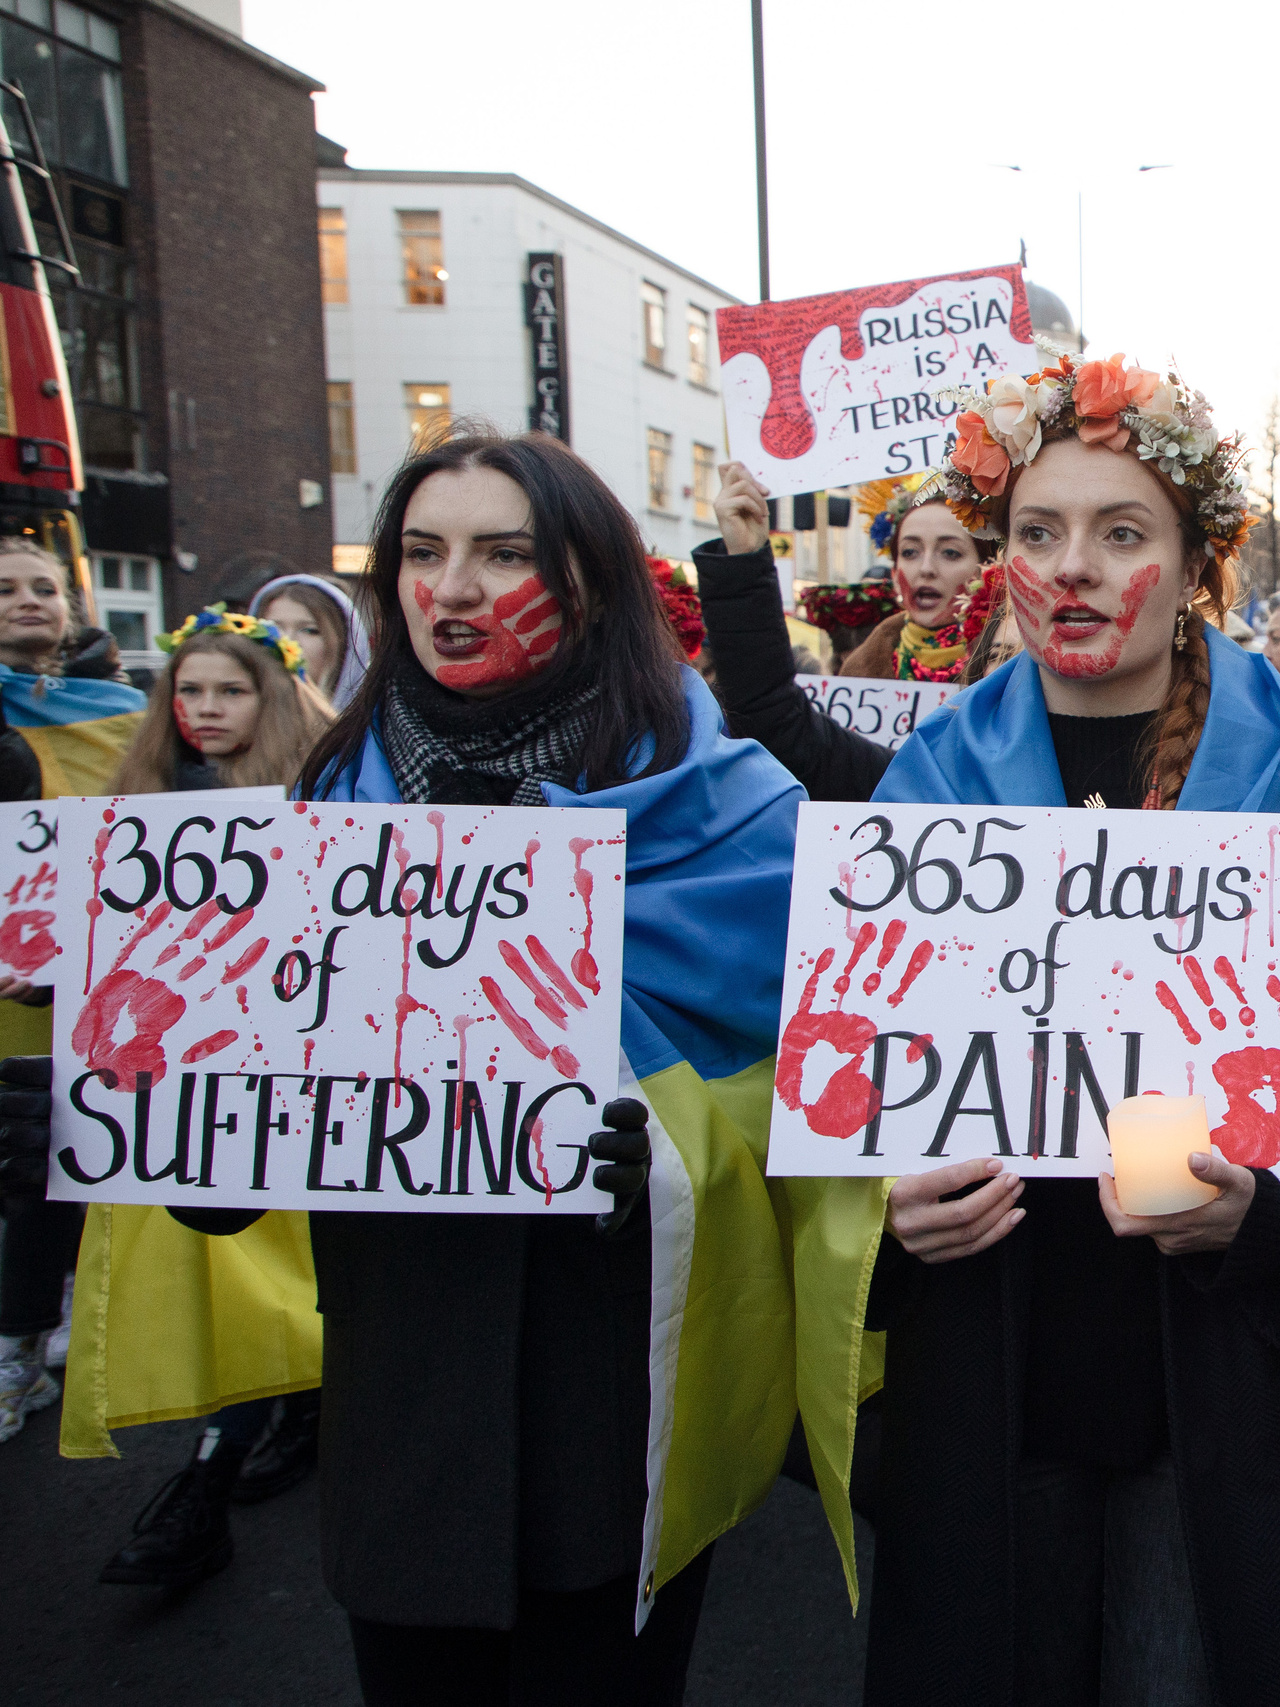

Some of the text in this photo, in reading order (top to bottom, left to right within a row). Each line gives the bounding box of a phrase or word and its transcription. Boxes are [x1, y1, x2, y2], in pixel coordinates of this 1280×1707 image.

[530, 261, 558, 370] GATE
[972, 342, 997, 370] A
[16, 809, 58, 854] 3
[829, 815, 1254, 955] 365 days
[100, 816, 529, 970] 365 days
[273, 925, 349, 1033] of
[998, 921, 1071, 1017] of
